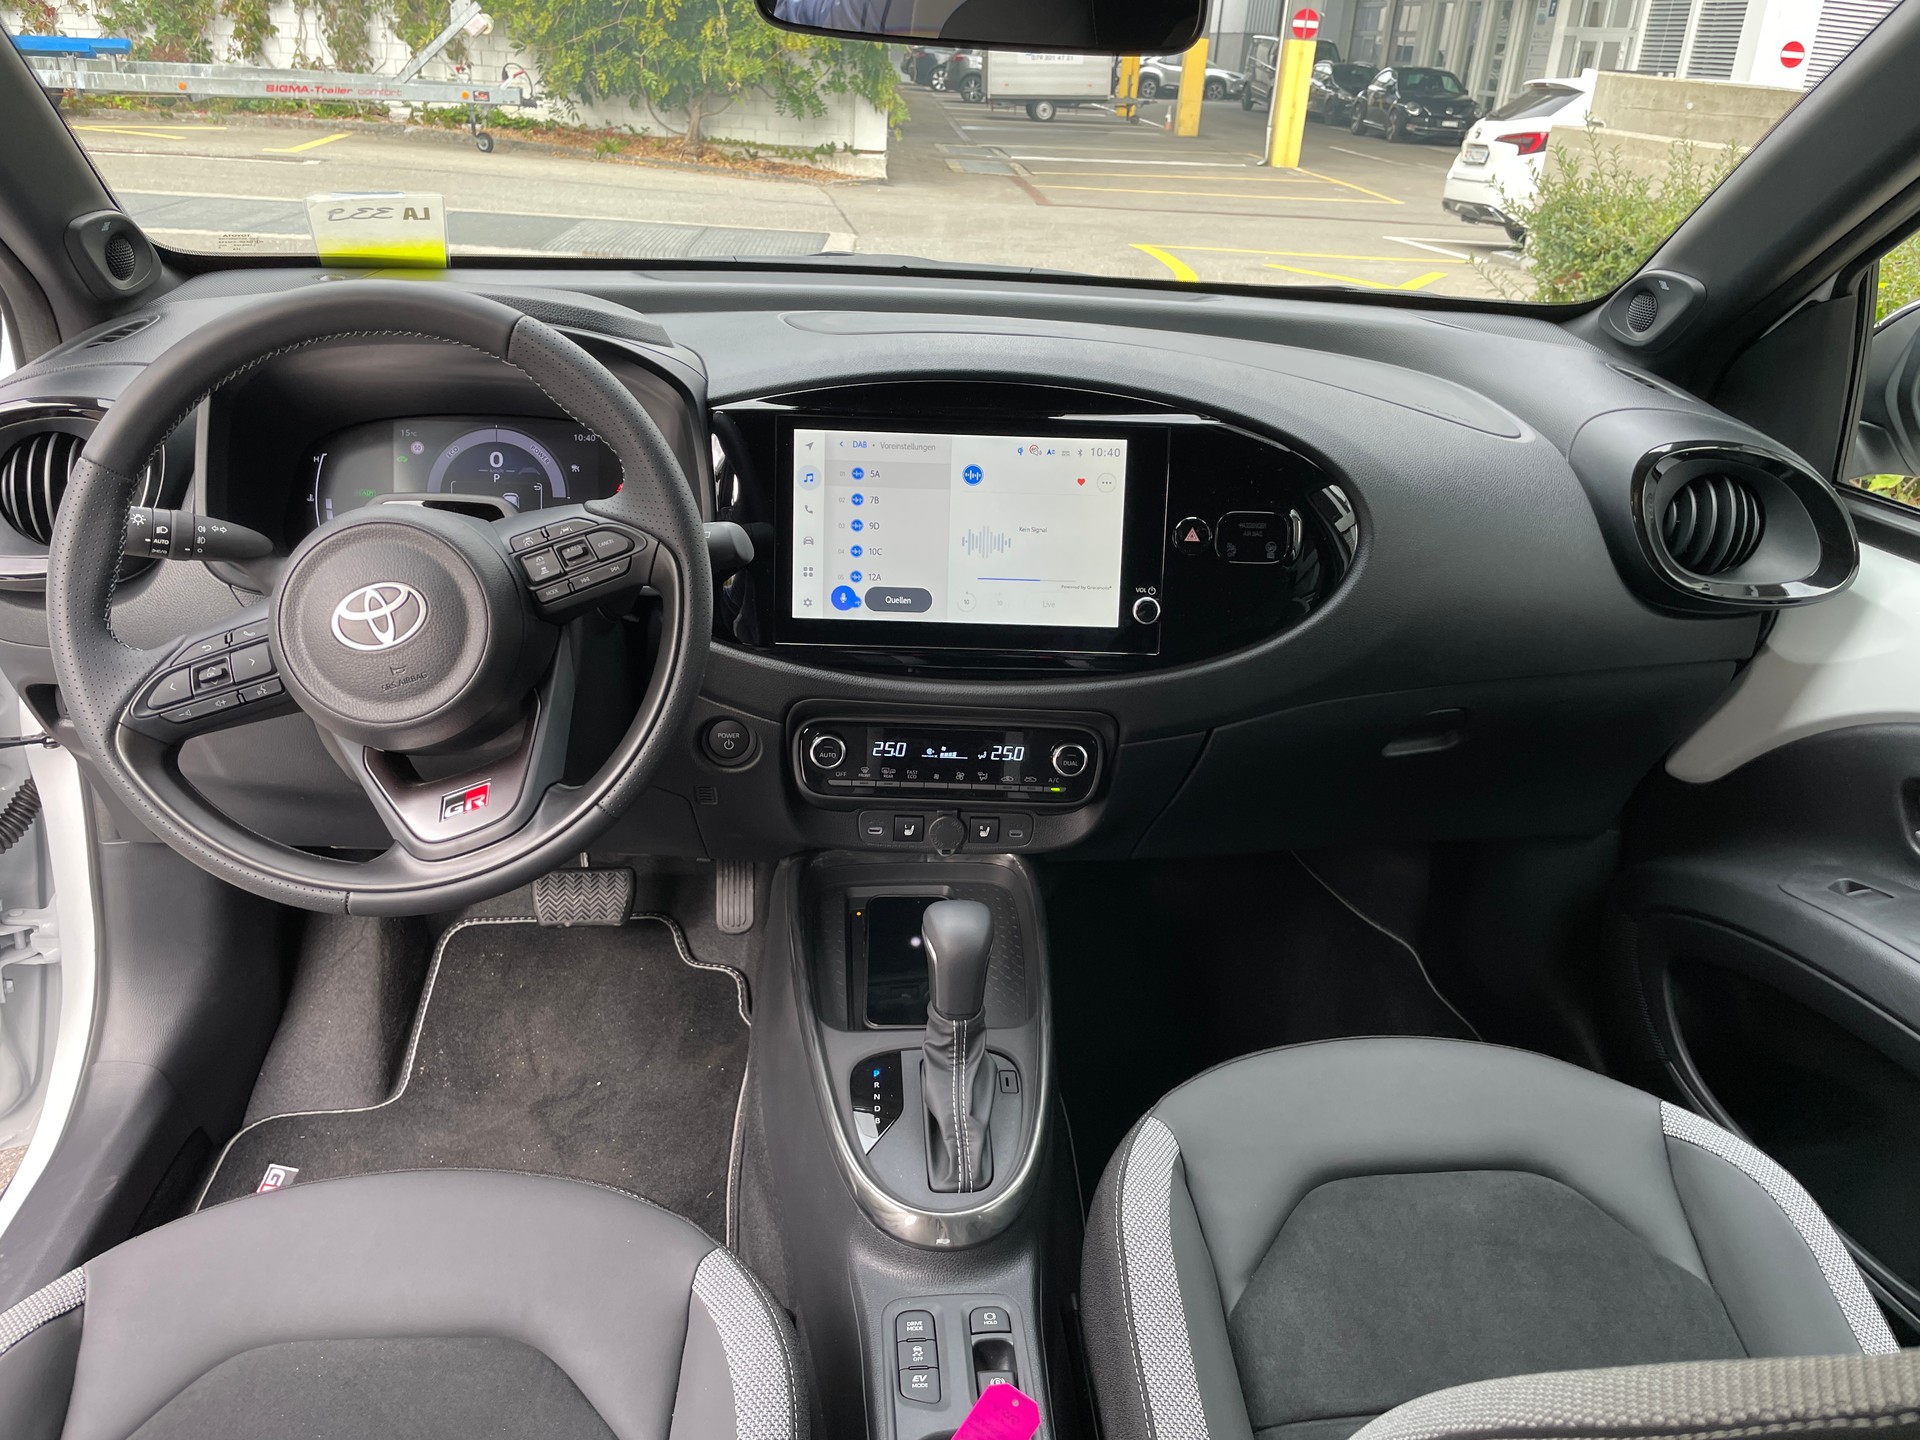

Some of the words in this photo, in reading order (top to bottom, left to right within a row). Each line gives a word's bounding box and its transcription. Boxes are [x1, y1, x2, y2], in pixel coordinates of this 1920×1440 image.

[265, 84, 353, 96] SIGMA-Trailer
[357, 88, 403, 96] comfort
[573, 434, 597, 442] 10:40
[852, 441, 868, 449] DAB
[880, 442, 936, 452] Voreinstellungen
[530, 444, 551, 464] POWER
[1090, 447, 1121, 458] 10:40
[489, 451, 504, 468] 0
[870, 470, 880, 478] 5A
[870, 496, 880, 504] 7B
[869, 522, 880, 530] 9D
[869, 548, 883, 556] 10C
[868, 573, 882, 581] 12A
[885, 596, 912, 604] Quellen
[398, 671, 429, 687] AIRBAG
[872, 741, 907, 757] 25.0
[990, 745, 1025, 761] 25.0
[444, 792, 487, 819] GR
[873, 1069, 880, 1077] P
[873, 1081, 880, 1089] R
[873, 1105, 881, 1113] D
[912, 1374, 927, 1382] EV
